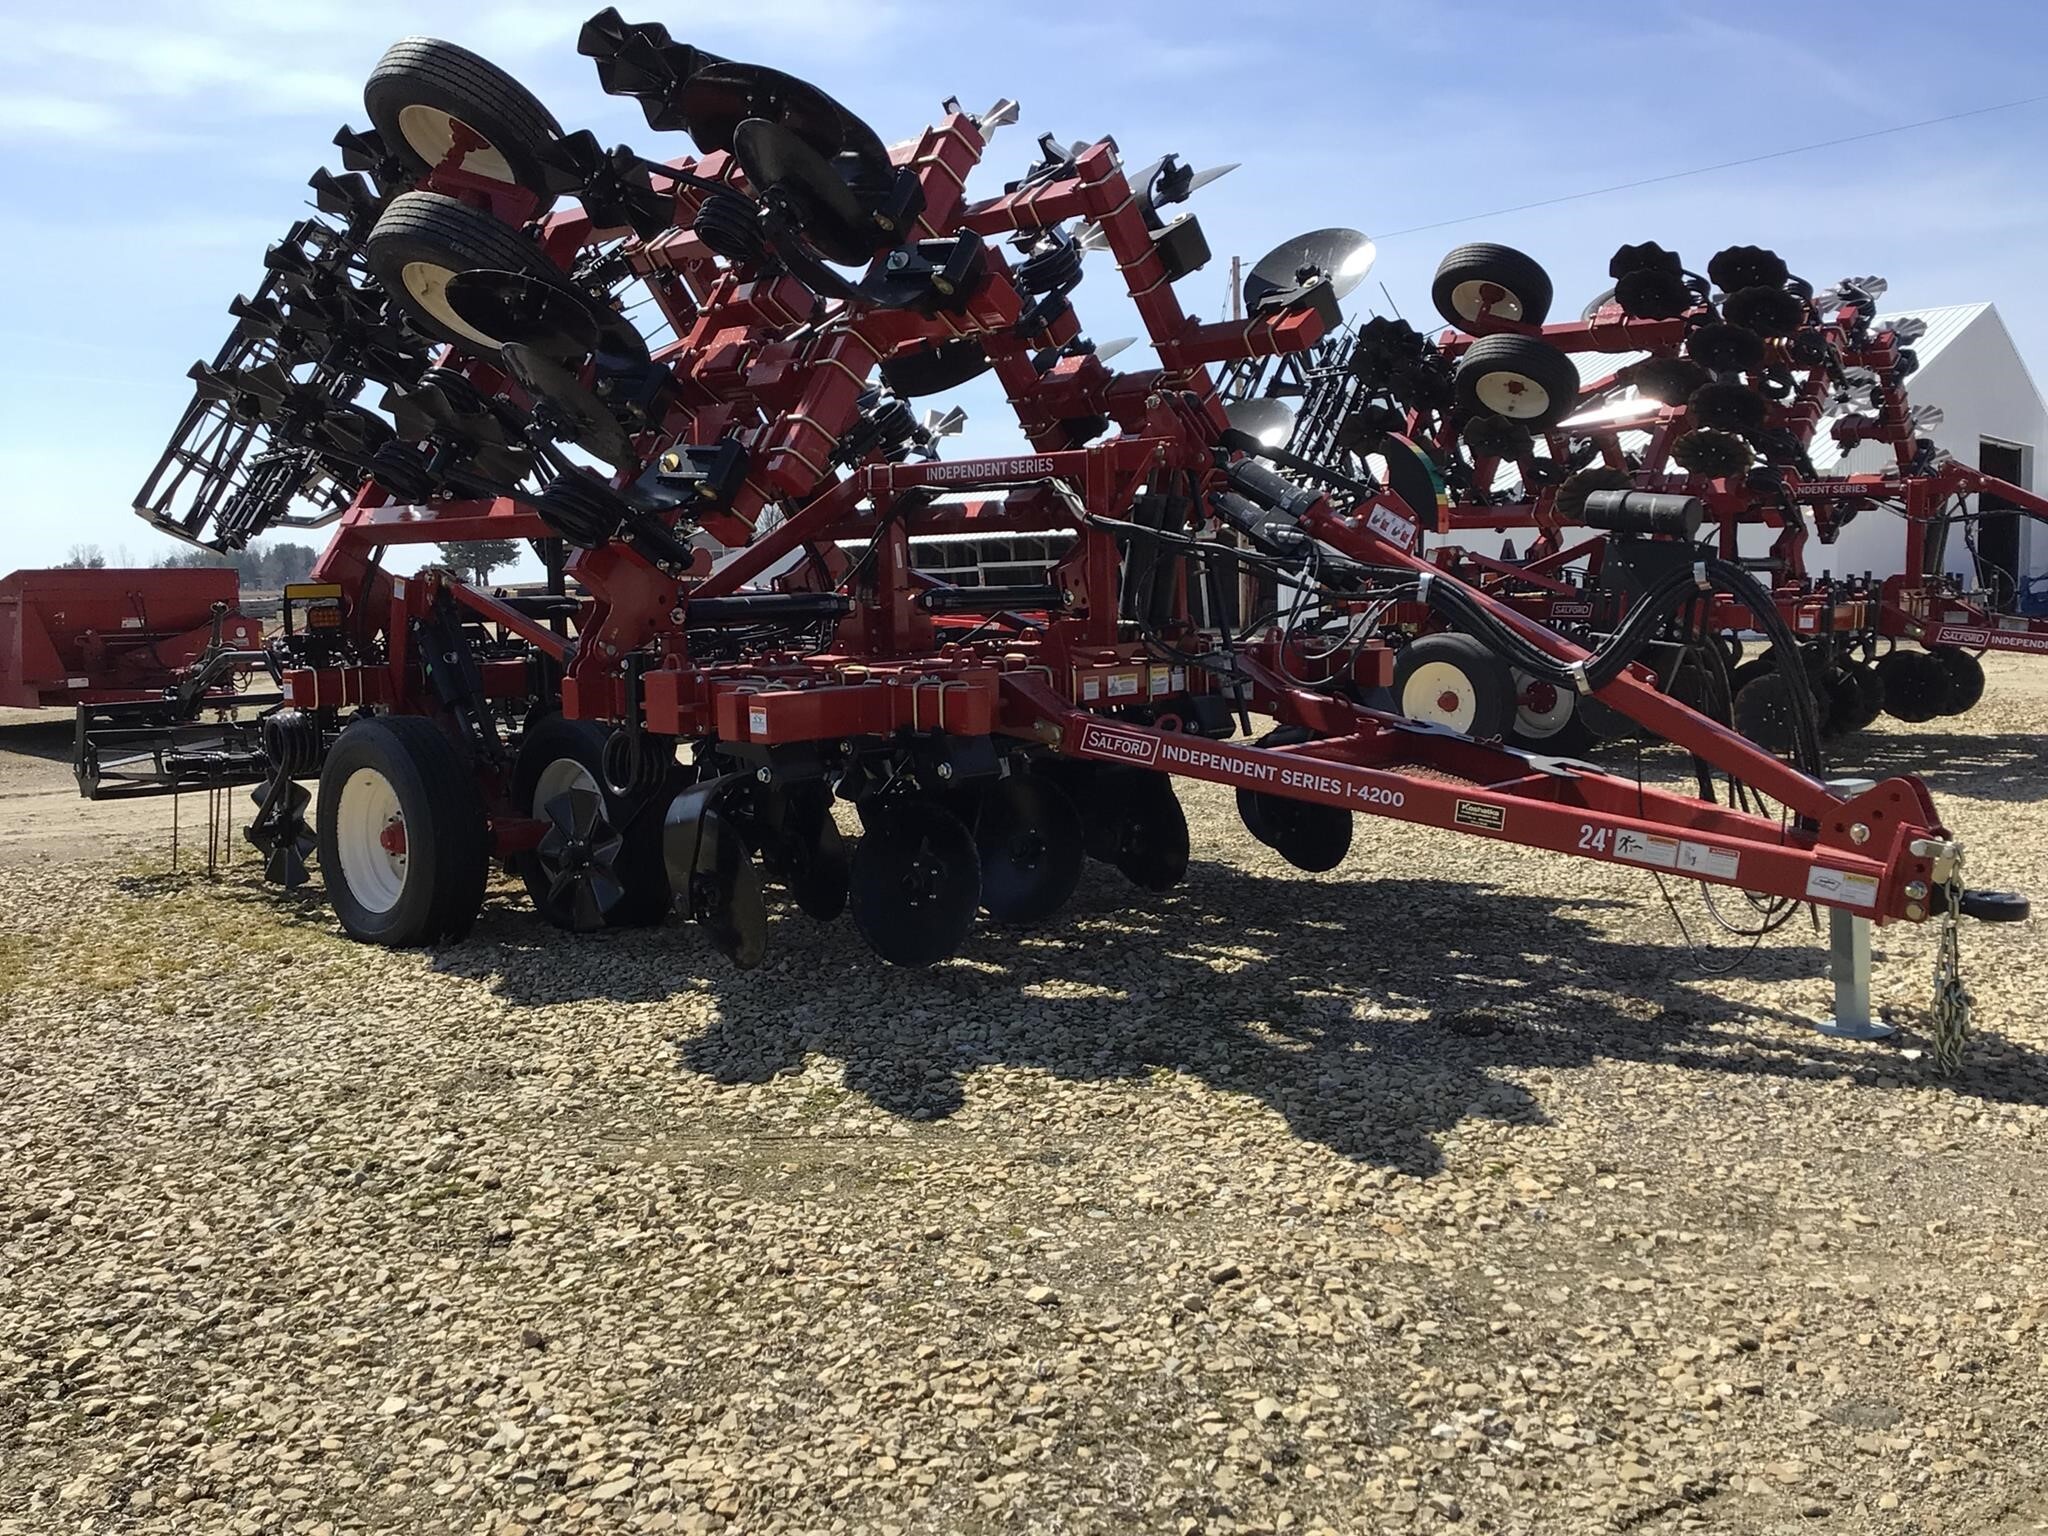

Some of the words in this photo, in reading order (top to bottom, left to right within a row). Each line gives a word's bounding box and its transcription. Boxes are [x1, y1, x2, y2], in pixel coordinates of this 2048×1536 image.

[926, 461, 1008, 481] INDEPENDENT
[1010, 458, 1054, 475] SERIES
[1832, 484, 1868, 494] SERIES
[1554, 605, 1589, 614] SALFORD
[1942, 630, 1985, 643] SALFORD
[1088, 731, 1152, 757] SALFORD
[1162, 744, 1278, 781] INDEPENDENT
[1280, 769, 1342, 795] SERIES
[1346, 782, 1405, 807] I-4200
[1578, 824, 1613, 851] 24'
